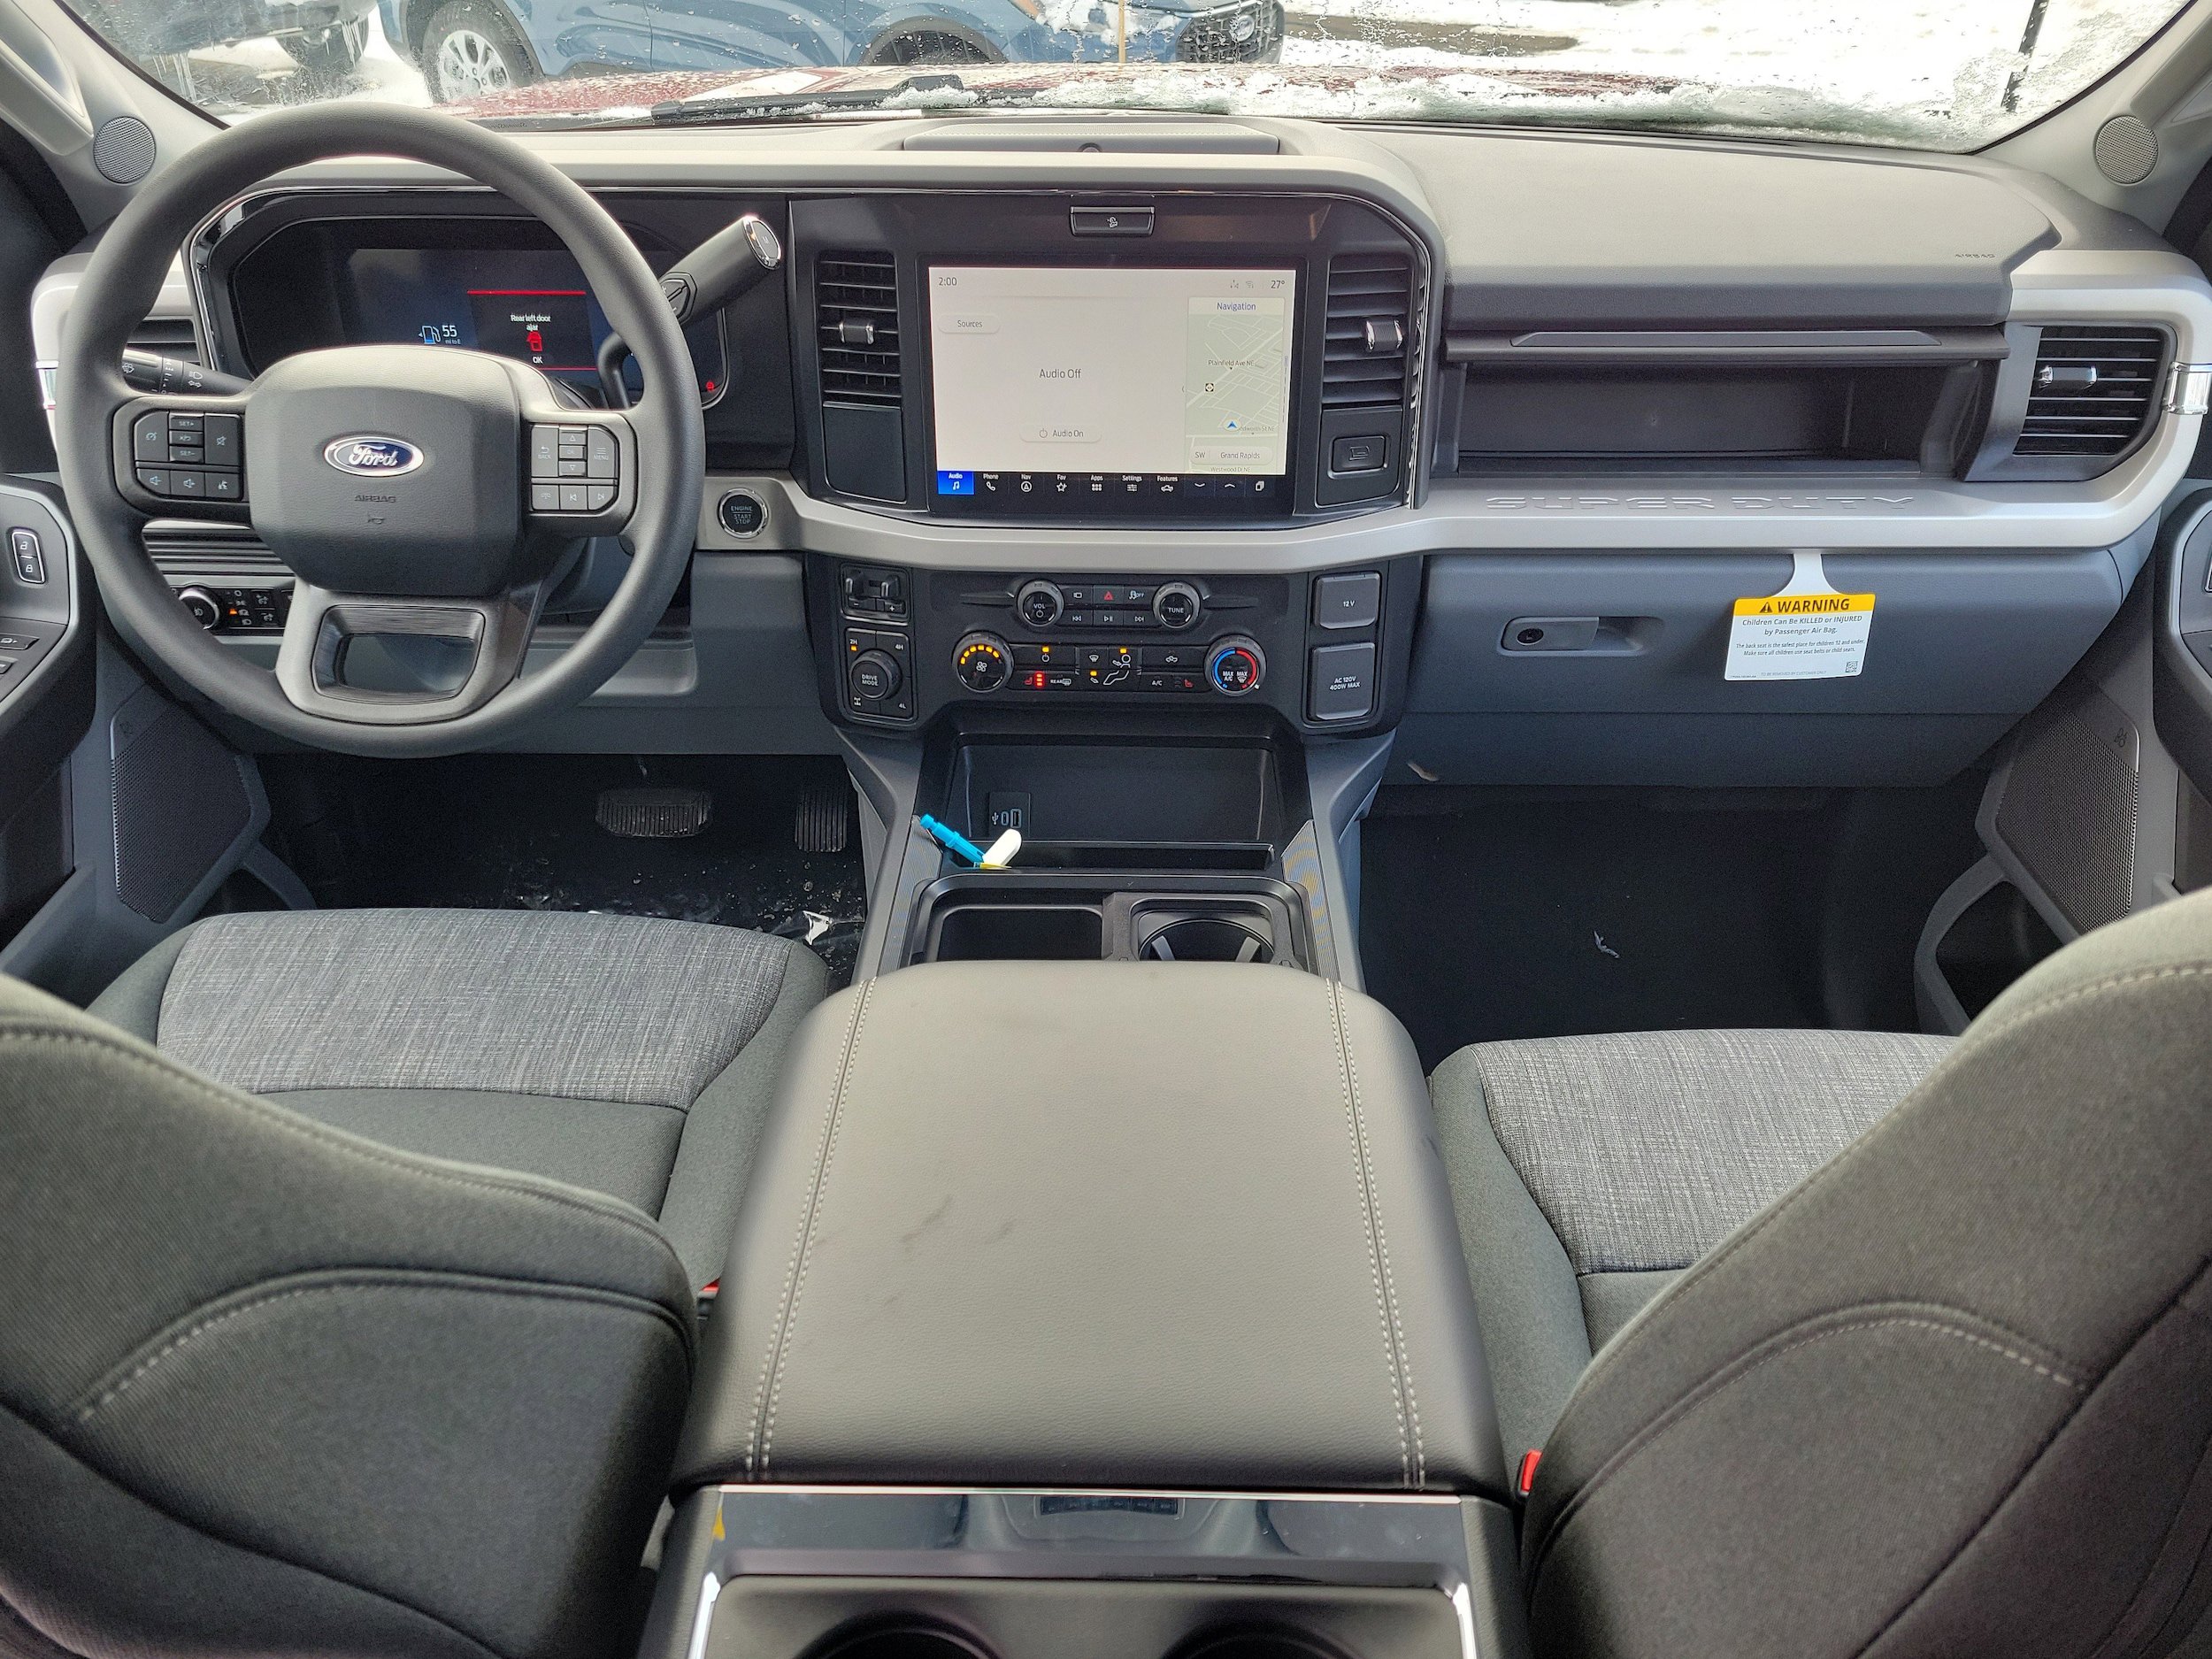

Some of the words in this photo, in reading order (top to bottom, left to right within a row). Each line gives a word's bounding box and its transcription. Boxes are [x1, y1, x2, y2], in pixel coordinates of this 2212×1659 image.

[939, 277, 957, 287] 2:00
[1217, 302, 1256, 311] Navigation
[957, 319, 983, 328] Sources
[442, 325, 457, 337] 55
[1039, 369, 1065, 379] Audio
[1067, 369, 1081, 379] Off
[348, 443, 399, 466] Ford
[1486, 496, 1715, 510] SUPER
[1731, 496, 1914, 510] DUTY
[1778, 598, 1850, 613] WARNING
